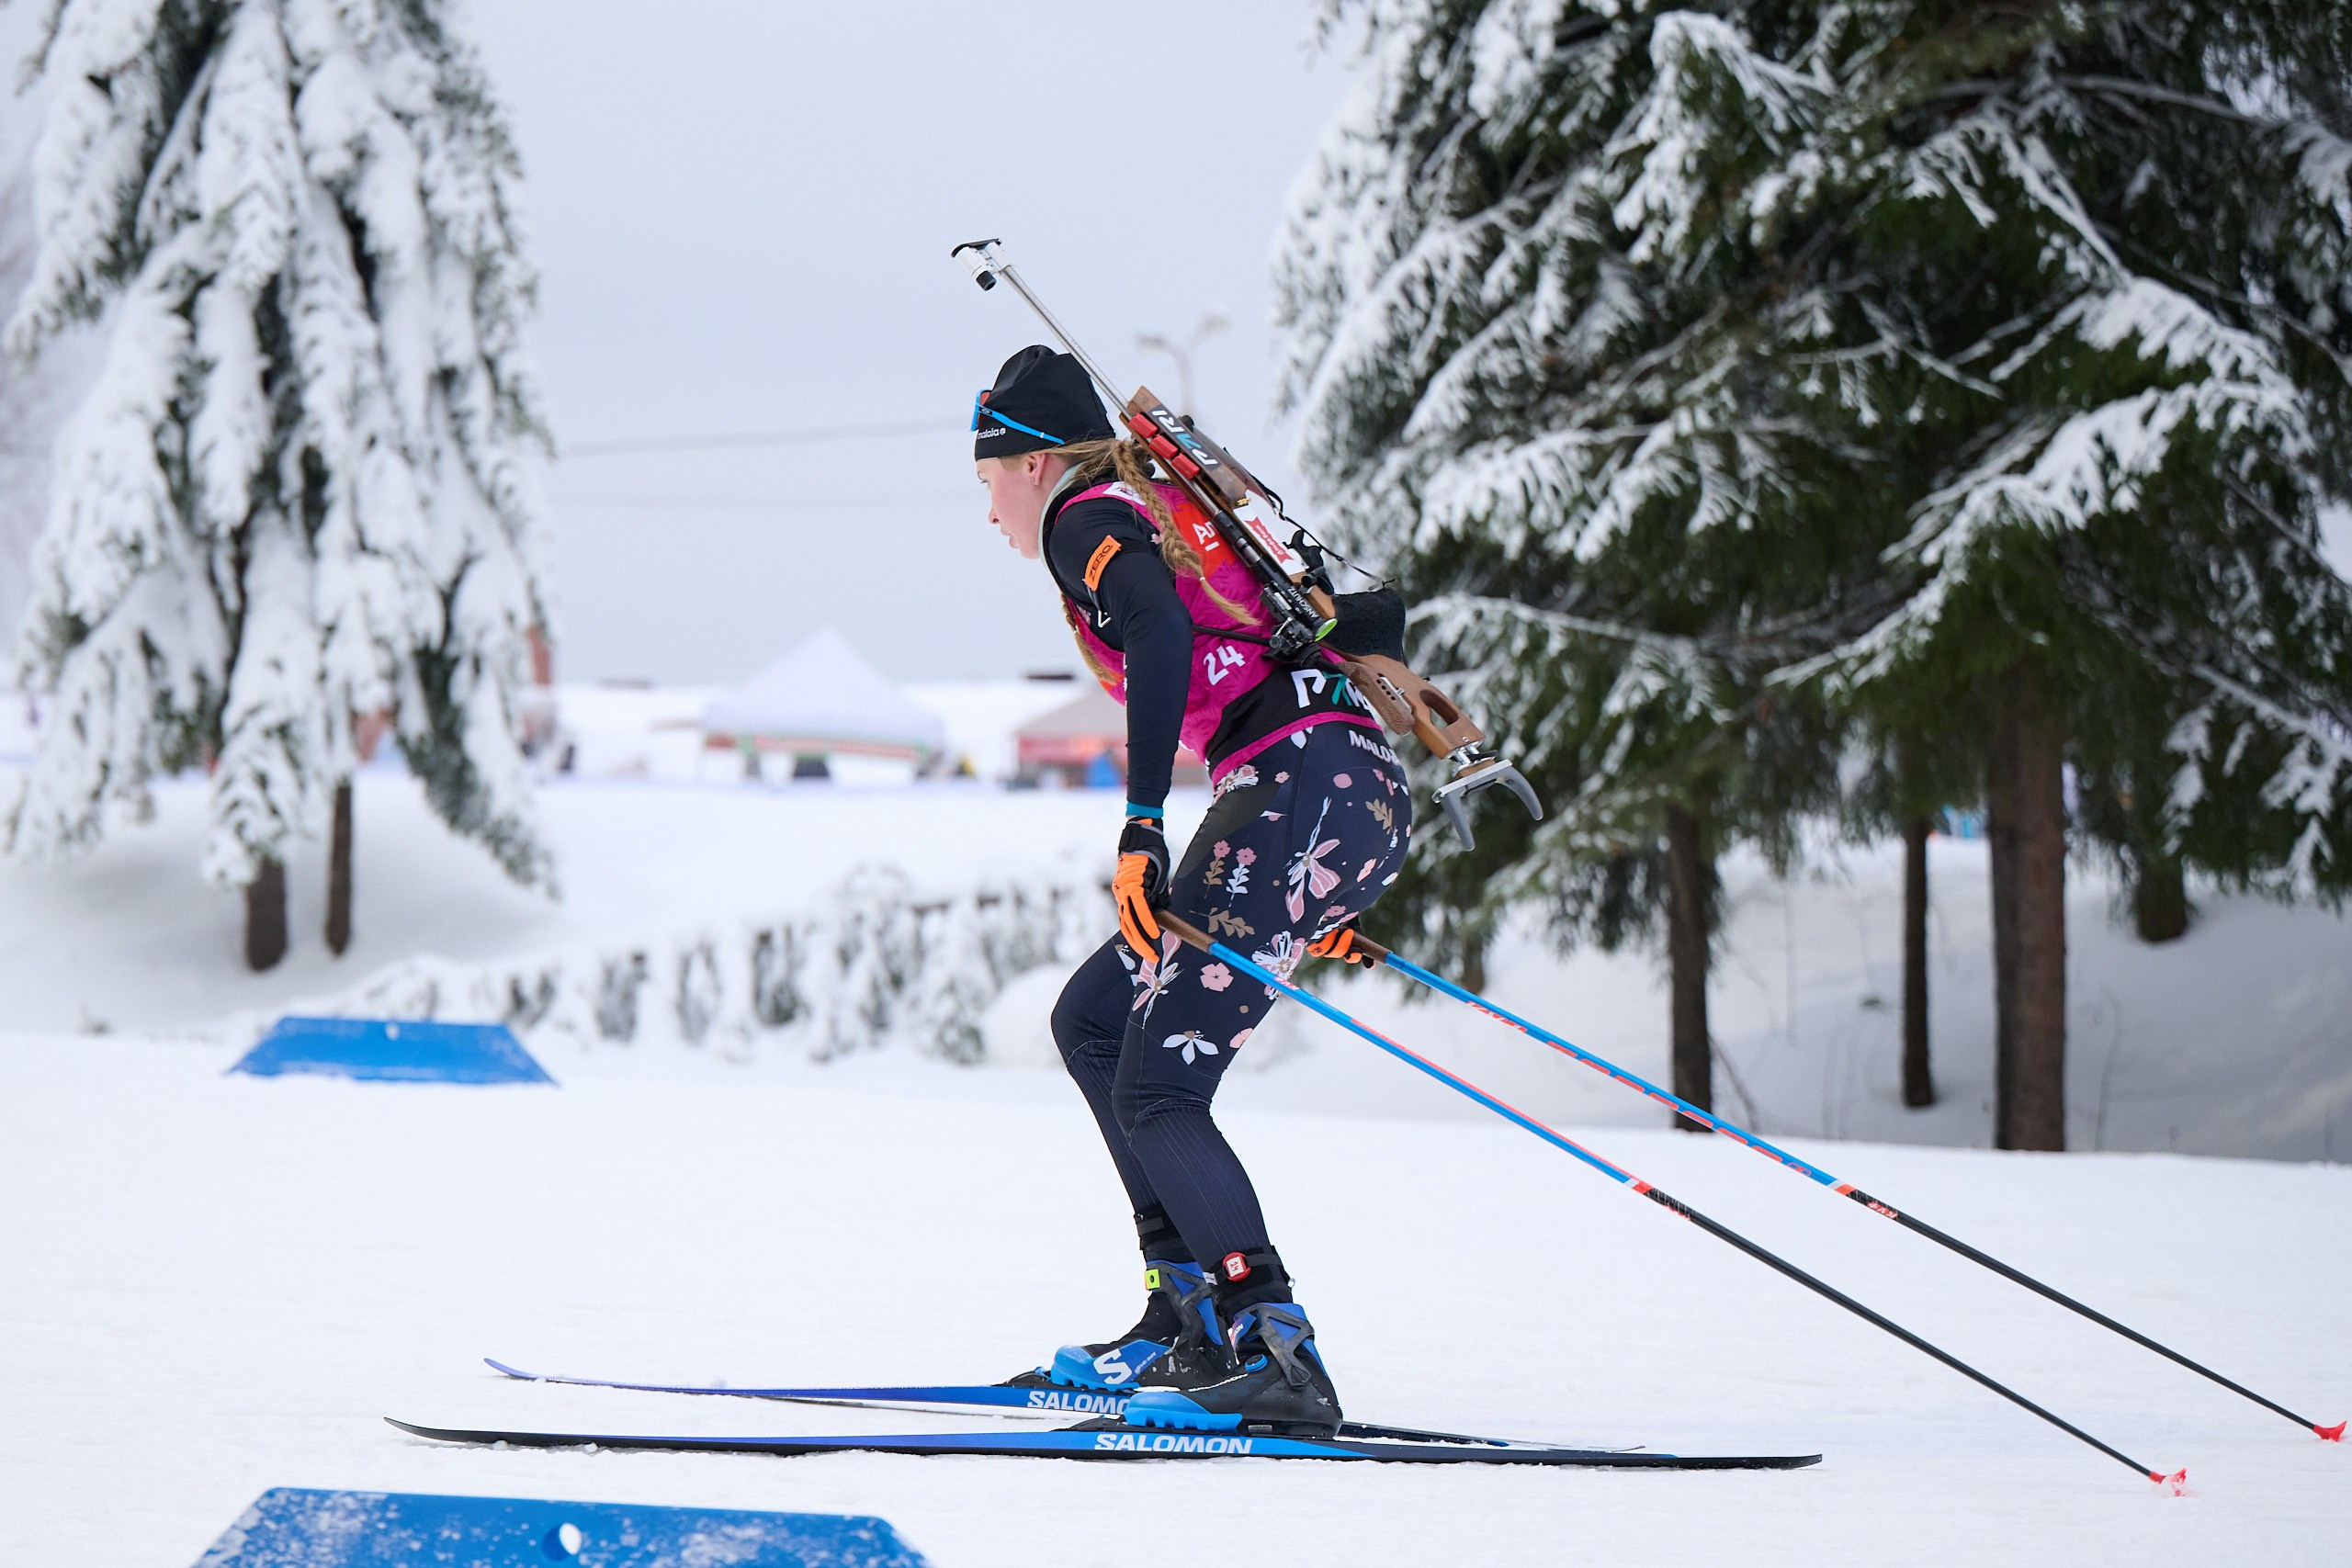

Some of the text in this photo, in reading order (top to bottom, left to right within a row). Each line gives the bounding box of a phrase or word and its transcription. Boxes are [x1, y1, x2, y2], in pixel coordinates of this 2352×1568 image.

[1151, 410, 1218, 466] PARI
[1089, 545, 1113, 582] ZERO
[1204, 645, 1246, 686] 24
[1027, 1391, 1130, 1415] SALOMO
[1094, 1434, 1252, 1453] SALOMON
